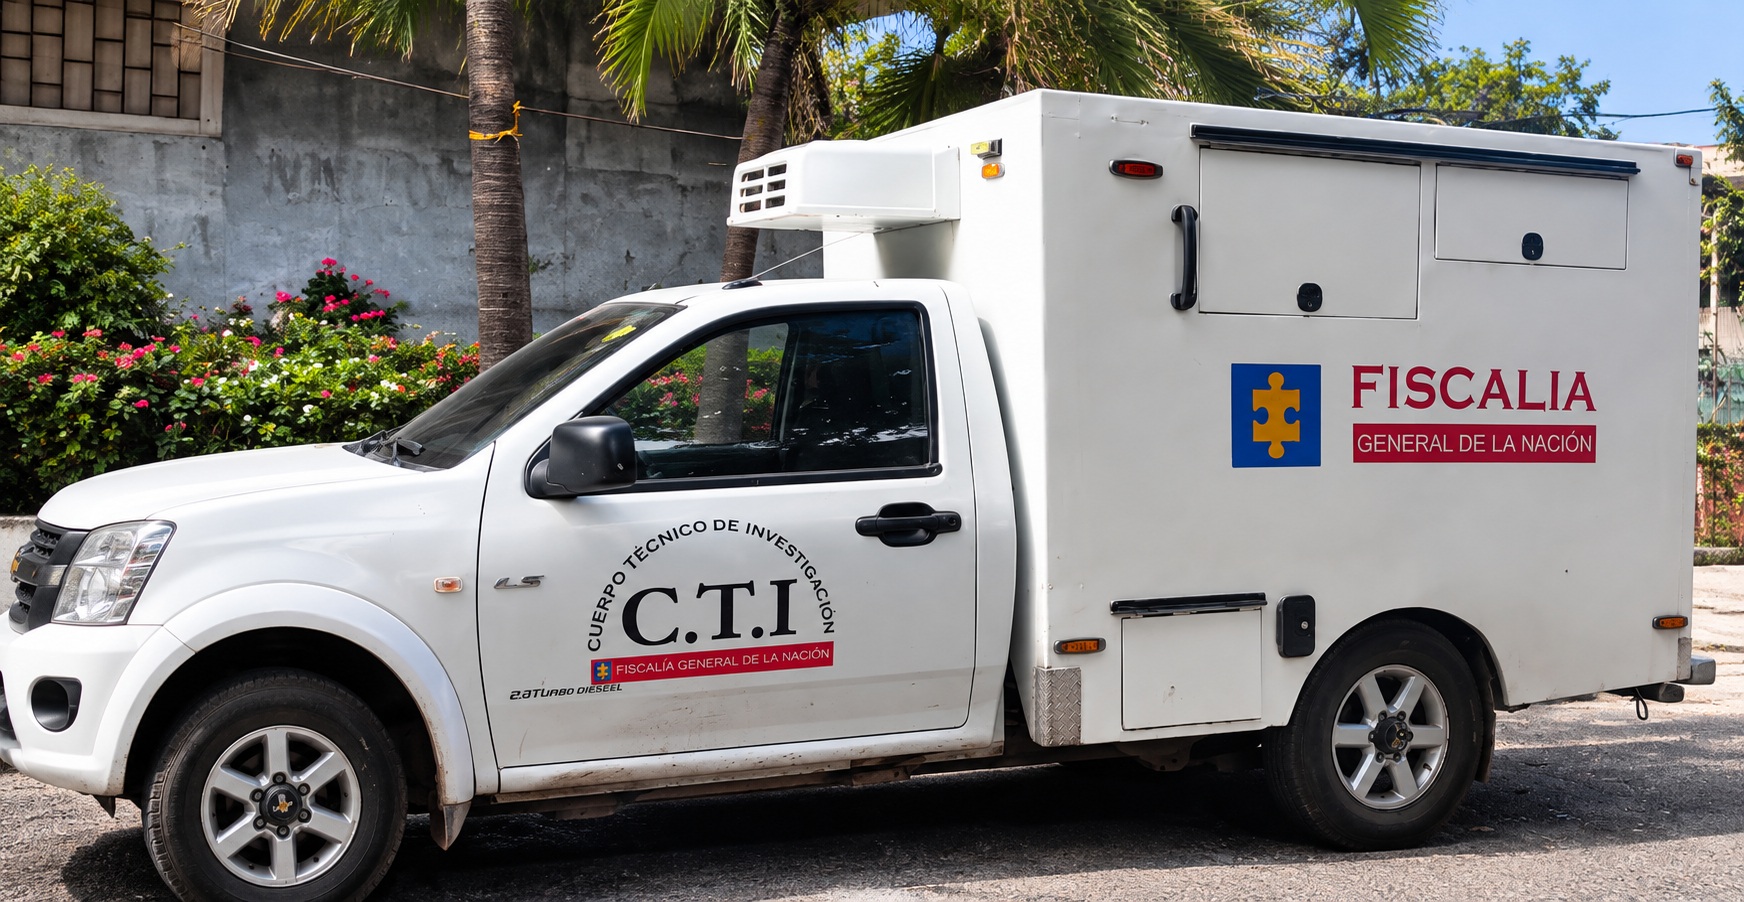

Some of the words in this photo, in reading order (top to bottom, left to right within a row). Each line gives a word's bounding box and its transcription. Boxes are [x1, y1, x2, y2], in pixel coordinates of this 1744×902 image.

[1352, 364, 1597, 411] FISCALIA
[1357, 434, 1454, 453] GENERAL
[1459, 434, 1486, 453] DE
[1492, 434, 1516, 453] LA
[1521, 430, 1592, 453] NACIÓN
[587, 571, 626, 651] CUERPO
[622, 520, 707, 570] TÉCNICO
[713, 519, 739, 532] DE
[745, 522, 836, 634] INVESTIGACIÓN
[622, 578, 798, 647] C.T.I
[616, 658, 674, 676] FISCALÍA
[678, 656, 739, 670] GENERAL
[742, 653, 759, 666] DE
[763, 651, 779, 664] LA
[782, 646, 830, 662] NACIÓN
